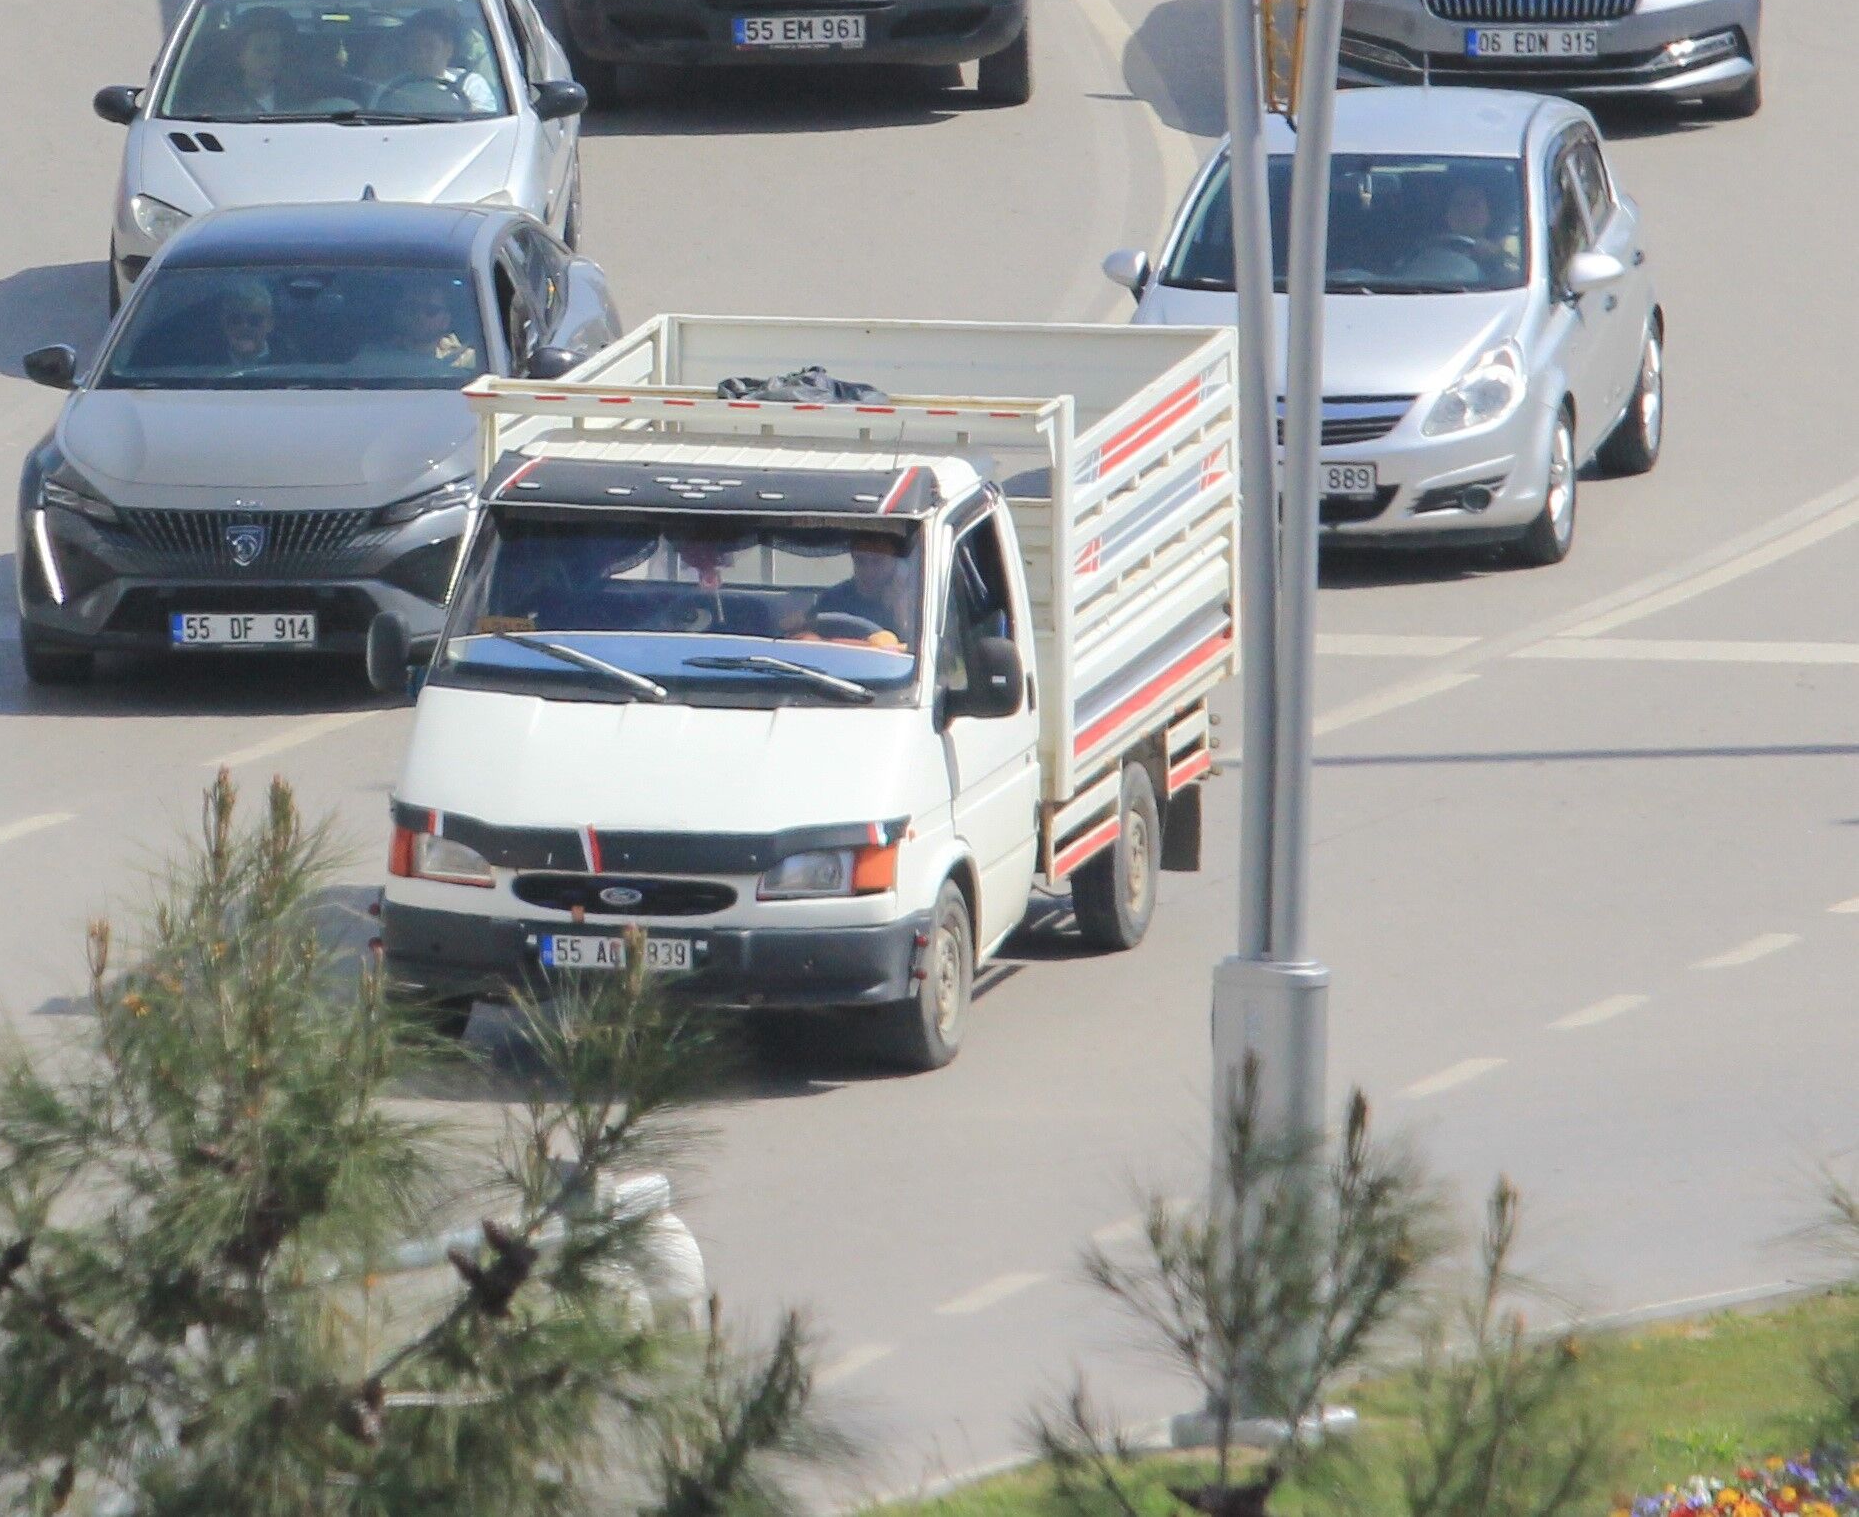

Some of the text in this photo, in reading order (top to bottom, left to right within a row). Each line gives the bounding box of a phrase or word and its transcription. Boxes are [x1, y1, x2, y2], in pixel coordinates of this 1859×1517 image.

[746, 18, 861, 41] 55 EM 961
[1479, 32, 1501, 53] 06
[1561, 31, 1596, 53] 915
[1329, 468, 1369, 489] 889
[186, 616, 310, 640] 55 DF 914
[556, 938, 582, 964] 55
[646, 941, 686, 966] 839
